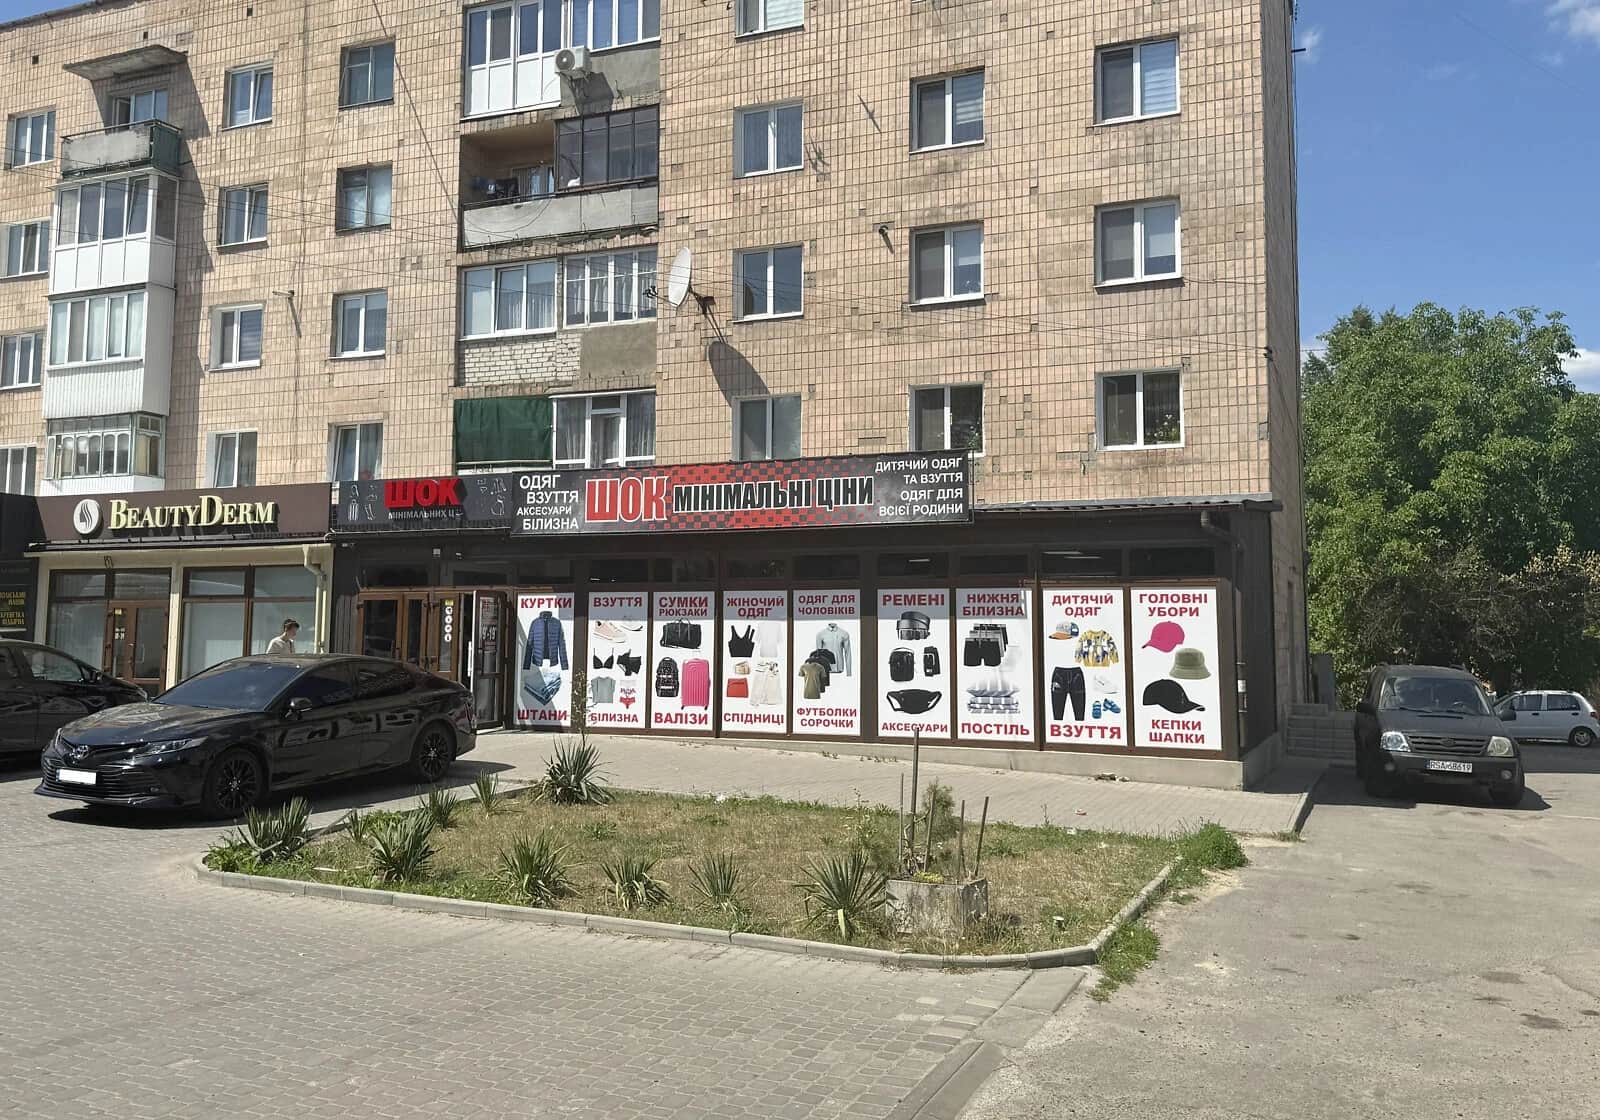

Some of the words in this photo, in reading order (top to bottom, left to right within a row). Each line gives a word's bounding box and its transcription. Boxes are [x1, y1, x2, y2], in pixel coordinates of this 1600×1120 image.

[875, 459, 928, 473] ДИТЯЧИЙ
[933, 457, 963, 471] ОДЯГ
[519, 474, 561, 490] ОДЯГ
[903, 474, 917, 486] ТА
[920, 472, 964, 485] ВЗУТТЯ
[384, 477, 461, 508] ШОК
[526, 490, 580, 505] ВЗУТТЯ
[672, 480, 812, 513] МІНІМАЛЬНІ
[816, 476, 876, 511] ЦІНИ
[900, 489, 932, 502] ОДЯГ
[936, 488, 964, 501] ДЛЯ
[585, 476, 669, 522] ШОК
[388, 510, 447, 520] МІНІМАЛЬНИХ
[516, 506, 573, 517] АКСЕСУАРИ
[878, 504, 912, 518] ВСІЄЇ
[913, 503, 965, 517] РОДИНИ
[522, 517, 580, 531] БІЛИЗНА
[520, 597, 573, 609] КУРТКИ
[592, 597, 643, 608] ВЗУТТЯ
[658, 596, 709, 608] СУМКИ
[727, 596, 785, 608] ЖІНОЧИЙ
[798, 595, 829, 606] ОДЯГ
[832, 594, 856, 605] ДЛЯ
[882, 594, 945, 607] РЕМЕНІ
[966, 593, 1020, 604] НИЖНЯ
[1138, 593, 1208, 604] ГОЛОВНІ
[658, 608, 708, 617] РЮКЗАКИ
[737, 607, 773, 618] ОДЯГ
[798, 606, 856, 616] ЧОЛОВІКІВ
[962, 605, 1025, 617] БІЛИЗНА
[1064, 607, 1102, 617] ОДЯГ
[1148, 606, 1200, 618] УБОРИ
[517, 709, 568, 721] ШТАНИ
[590, 712, 639, 723] БІЛИЗНА
[654, 712, 708, 725] ВАЛІЗИ
[723, 712, 784, 725] СПІДНИЦІ
[796, 707, 857, 718] ФУТБОЛКИ
[800, 718, 854, 728] СОРОЧКИ
[881, 723, 948, 732] АКСЕСУАРИ
[961, 723, 1030, 735] ПОСТІЛЬ
[1151, 719, 1201, 731] КЕПКИ
[1050, 724, 1121, 739] ВЗУТТЯ
[1149, 732, 1205, 744] ШАПКИ
